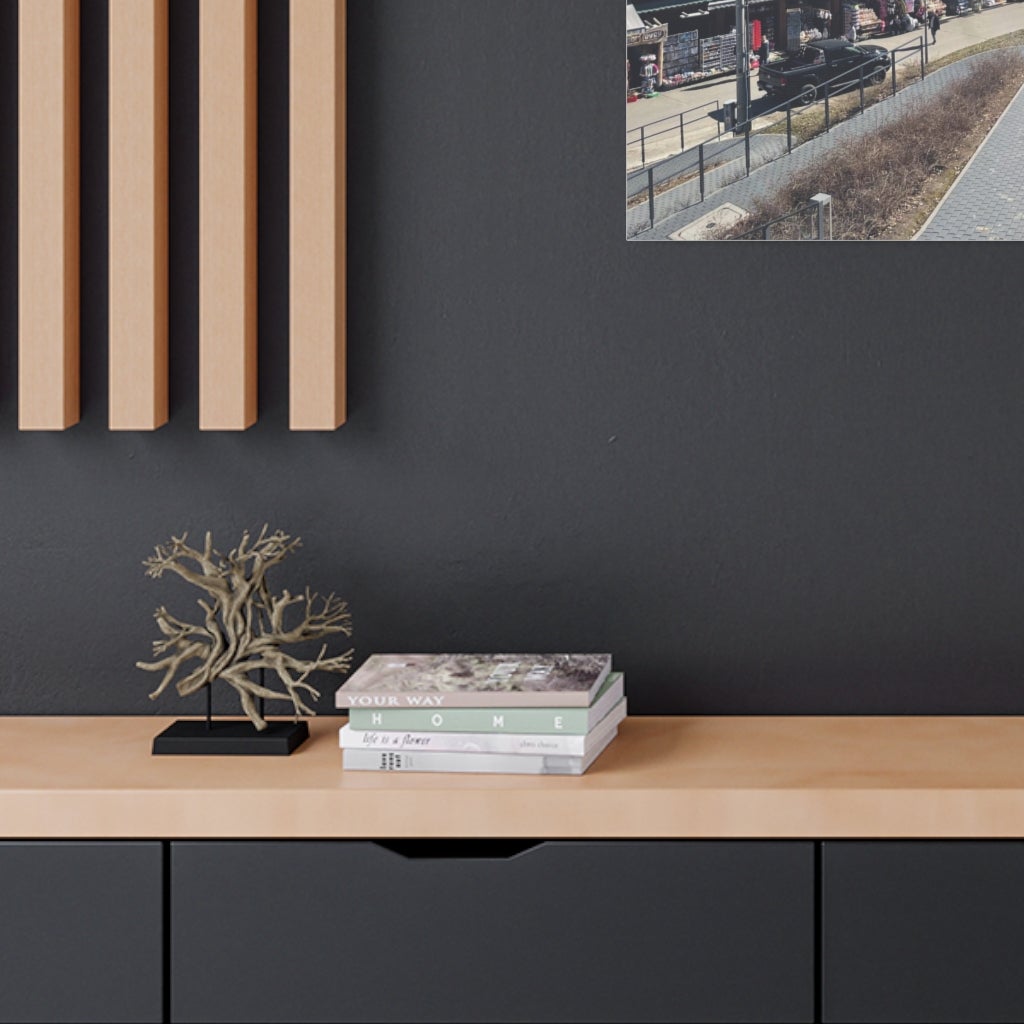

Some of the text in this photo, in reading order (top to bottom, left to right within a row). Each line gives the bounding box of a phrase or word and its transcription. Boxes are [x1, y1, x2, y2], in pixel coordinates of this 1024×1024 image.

[348, 695, 445, 706] YOUR WAY
[362, 732, 378, 747] life
[400, 733, 431, 748] flower
